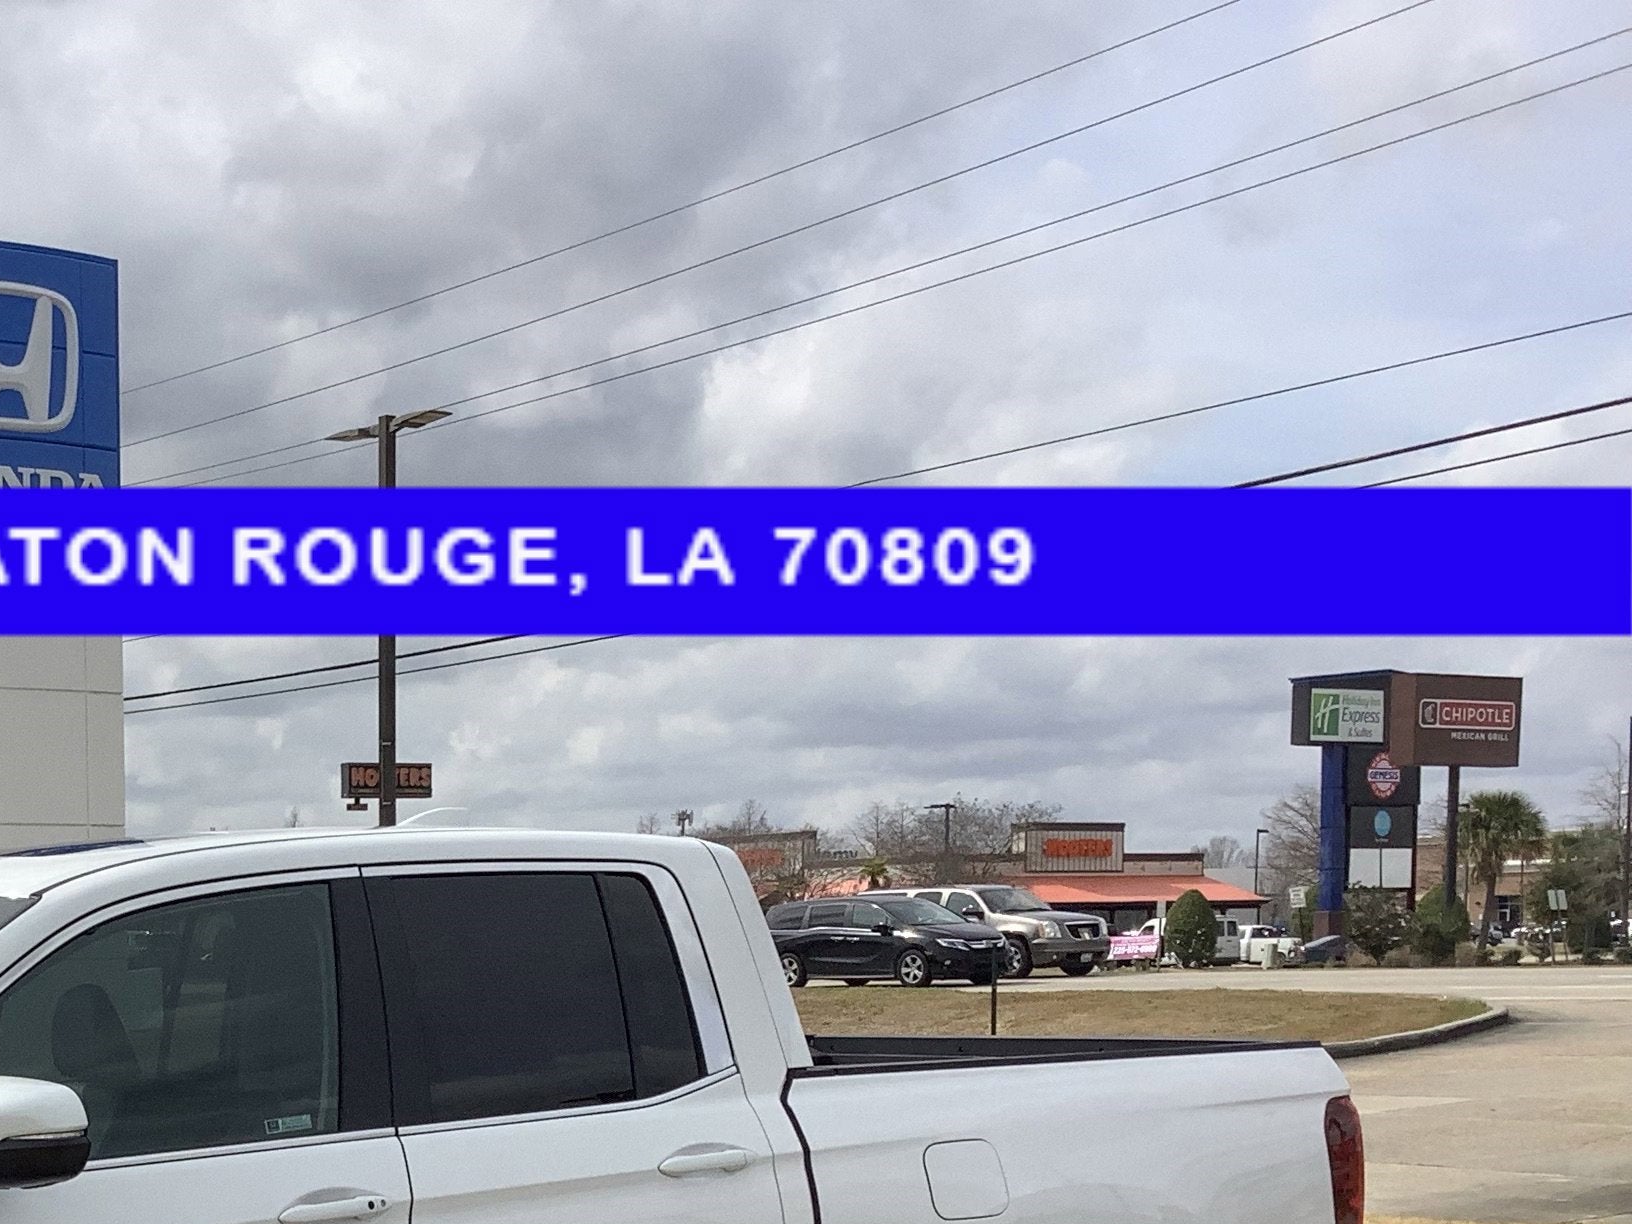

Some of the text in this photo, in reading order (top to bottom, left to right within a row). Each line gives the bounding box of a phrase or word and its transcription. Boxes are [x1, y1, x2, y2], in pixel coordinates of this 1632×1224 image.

[1342, 707, 1381, 725] Express
[1441, 707, 1511, 723] CHIPOTLE
[1451, 731, 1486, 741] MEXICAN
[350, 766, 432, 787] HOERS
